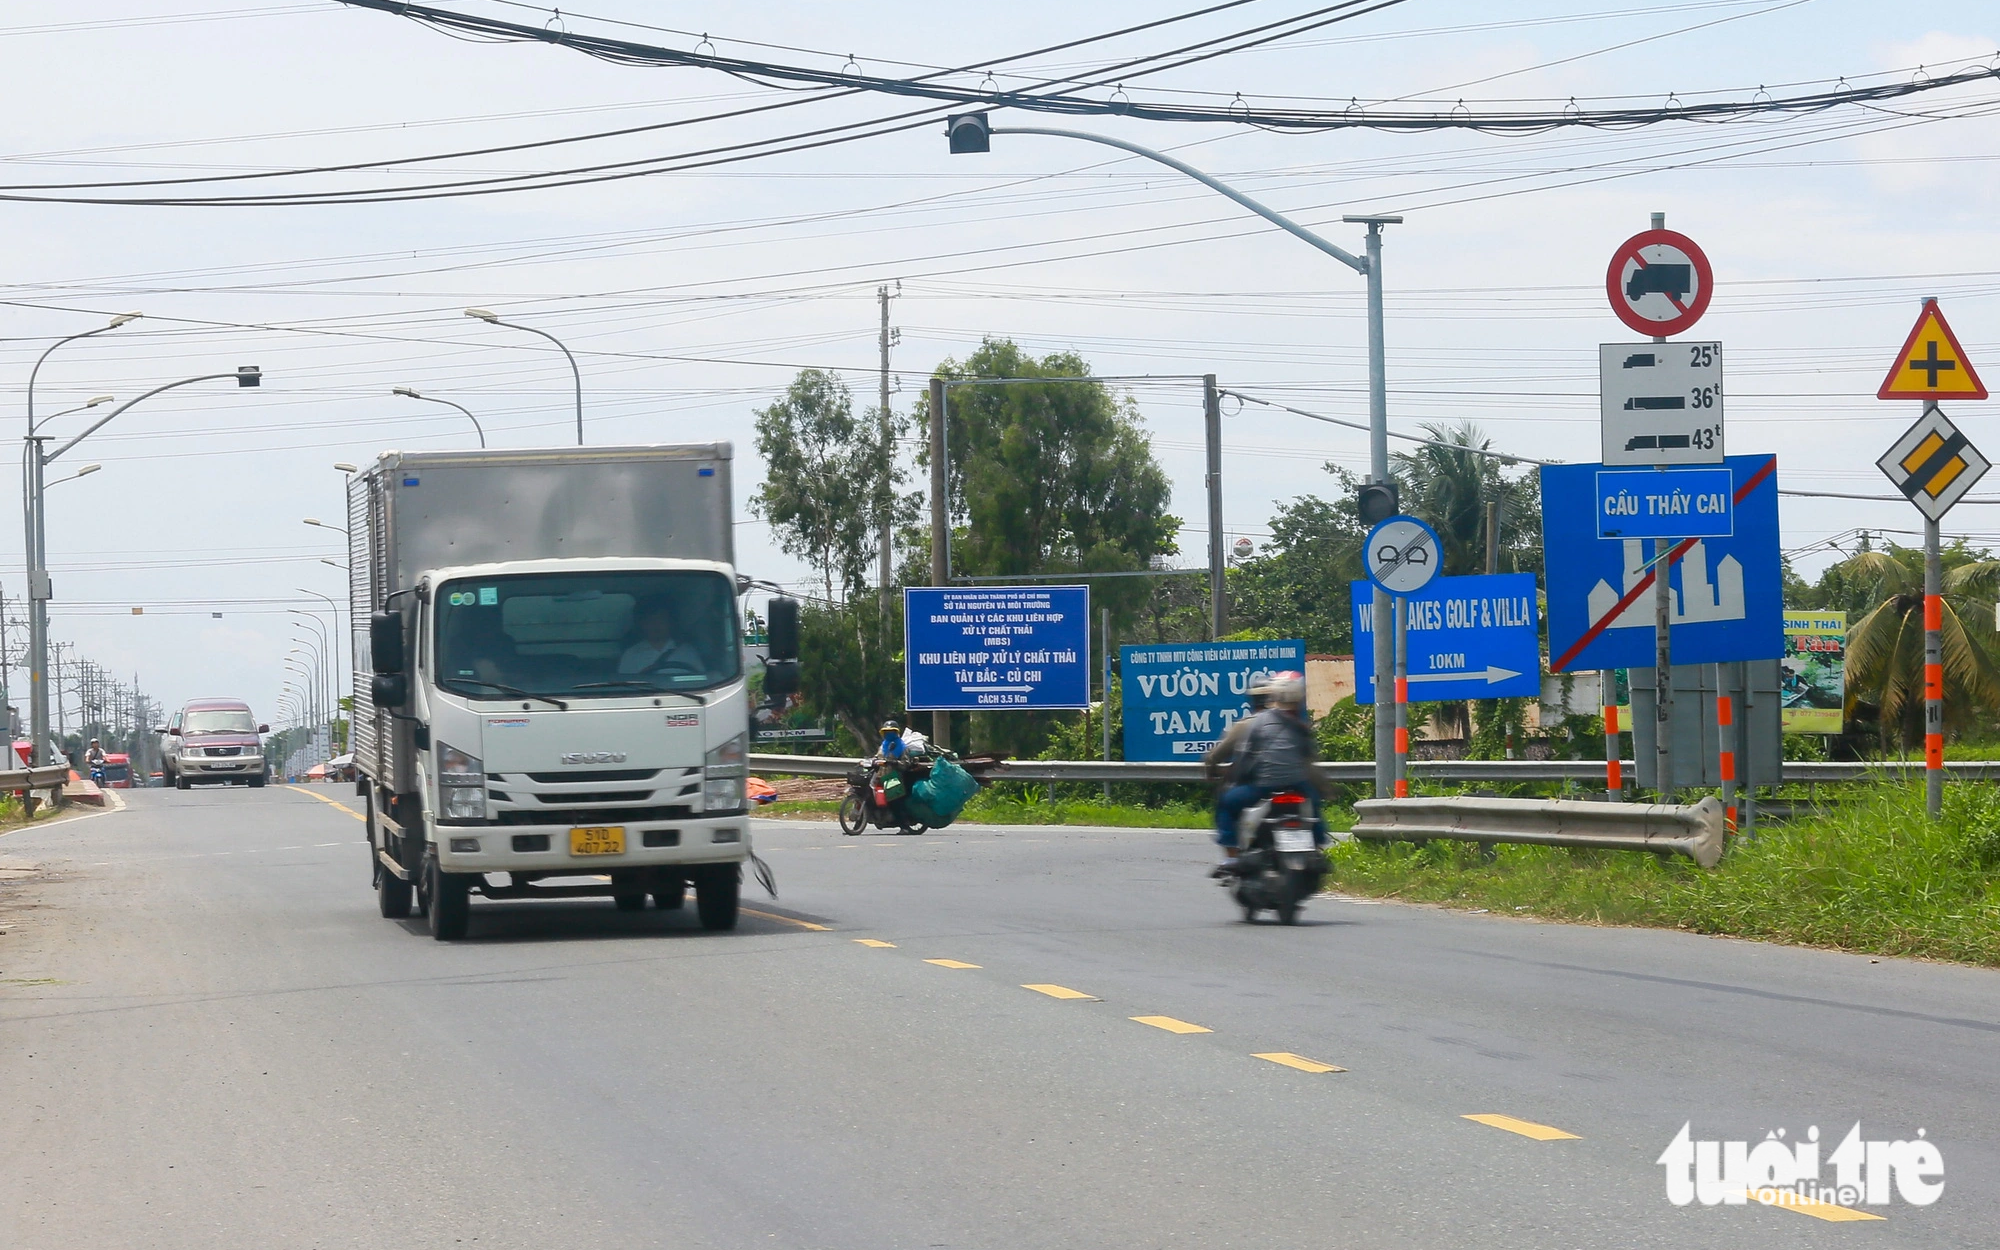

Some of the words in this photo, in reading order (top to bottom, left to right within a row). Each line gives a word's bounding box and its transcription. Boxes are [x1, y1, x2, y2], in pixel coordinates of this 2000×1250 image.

[1604, 489, 1638, 516] CẦU
[1646, 488, 1691, 514] THẦY
[1696, 494, 1725, 514] CAI
[944, 600, 954, 610] SỞ
[955, 600, 966, 610] TÀI
[967, 600, 995, 610] NGUYÊN
[997, 600, 1006, 610] VÀ
[1008, 601, 1021, 610] MÔI
[1023, 600, 1050, 609] TRƯỜNG
[1446, 598, 1478, 630] GOLF
[1481, 598, 1492, 628] &
[1492, 596, 1530, 627] VILLA
[930, 615, 948, 623] BAN
[950, 612, 973, 624] QUẢN
[976, 613, 986, 623] LÝ
[987, 612, 1004, 622] CÁC
[1006, 614, 1024, 622] KHU
[1026, 612, 1044, 622] LIÊN
[1046, 613, 1064, 624] HỢP
[1783, 620, 1810, 630] SINH
[1814, 618, 1842, 630] THÁI
[962, 625, 975, 635] XỬ
[976, 626, 986, 634] LÝ
[988, 624, 1012, 634] CHẤT
[1013, 624, 1032, 634] THẢI
[984, 637, 1011, 646] (MBS)
[1793, 636, 1840, 652] Tân
[919, 653, 940, 664] KHU
[943, 651, 966, 664] LIÊN
[968, 652, 990, 666] HỢP
[992, 649, 1008, 664] XỬ
[1009, 650, 1022, 664] LÝ
[1024, 648, 1050, 664] CHẤT
[1052, 648, 1076, 663] THẢI
[1130, 650, 1148, 664] CÔNG
[1148, 652, 1156, 664] TY
[1156, 652, 1172, 663] TNHH
[1173, 651, 1186, 662] MTV
[1187, 648, 1204, 662] CÔNG
[1204, 648, 1219, 662] VIÊN
[1219, 648, 1232, 661] CÂY
[1232, 649, 1248, 660] XANH
[1249, 648, 1258, 660] TP.
[1258, 645, 1268, 659] HỒ
[1268, 646, 1280, 659] CHÍ
[1280, 647, 1296, 659] MINH
[1429, 653, 1465, 670] 10KM
[954, 669, 973, 683] TÂY
[976, 667, 998, 682] BẮC
[1007, 668, 1021, 682] CỦ
[1024, 670, 1042, 682] CHI
[1136, 666, 1220, 698] VƯỜN
[978, 694, 999, 704] CÁCH
[1000, 695, 1013, 703] 3.5
[1014, 695, 1028, 703] Km
[1150, 709, 1211, 735] TAM
[560, 752, 626, 765] ISUZU
